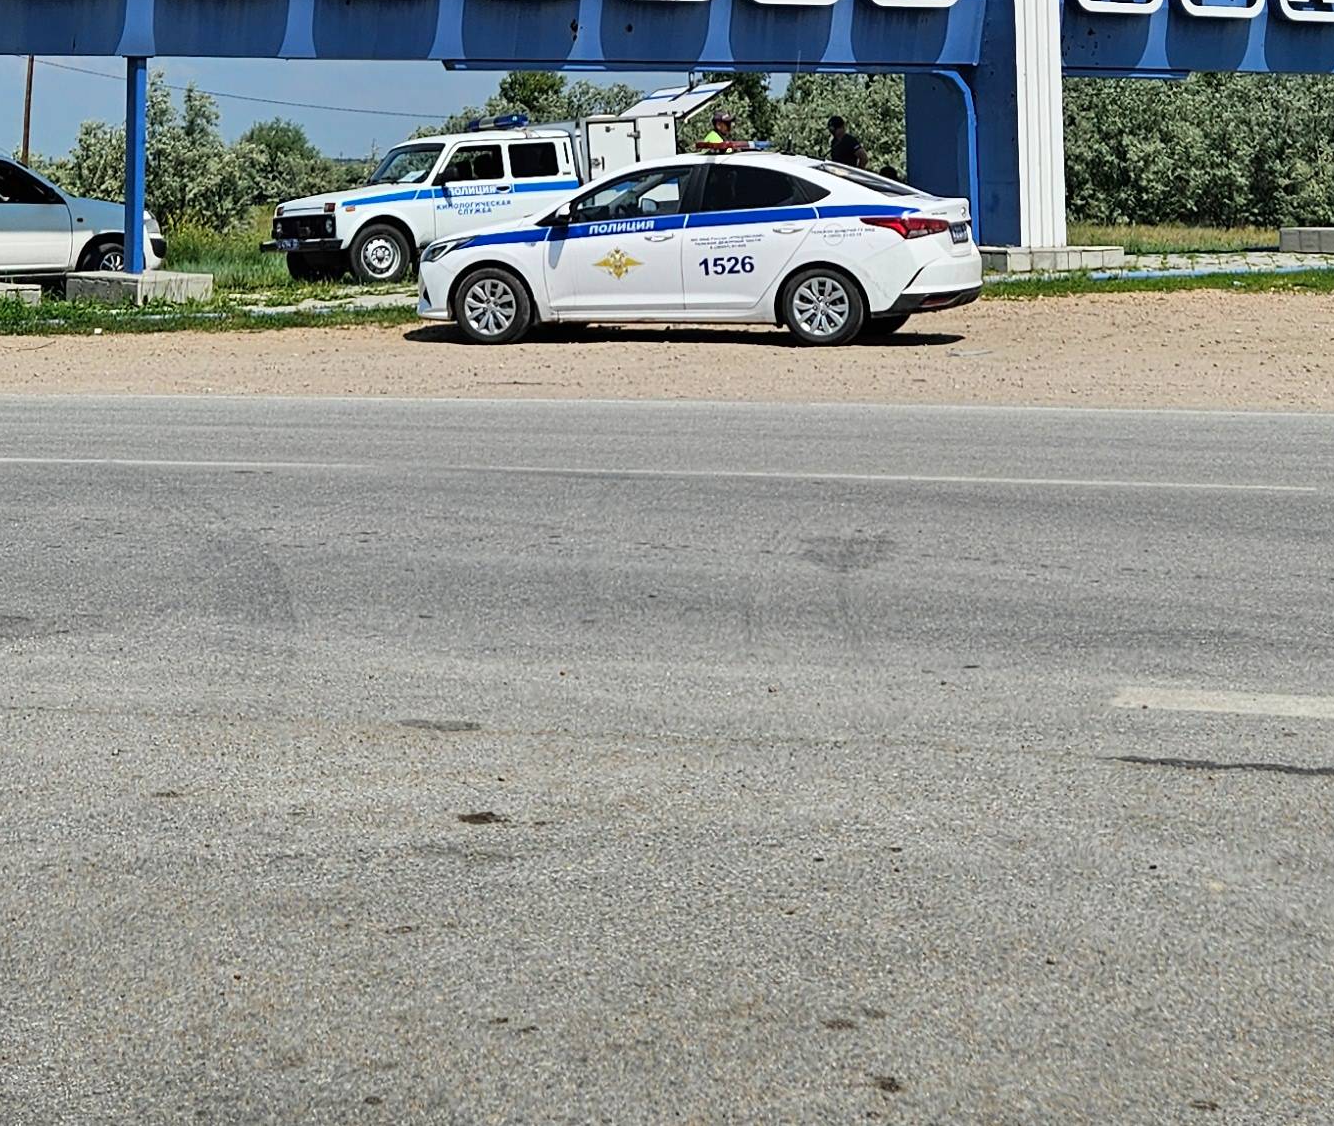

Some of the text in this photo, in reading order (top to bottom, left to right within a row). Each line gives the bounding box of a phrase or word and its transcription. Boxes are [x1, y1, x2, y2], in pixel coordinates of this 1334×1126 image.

[436, 199, 511, 210] КИНОЛОГИЧЕСКАЯ
[457, 208, 492, 216] СЛУЖБА
[589, 219, 655, 235] ПОЛИЦИЯ
[699, 255, 755, 276] 1526
